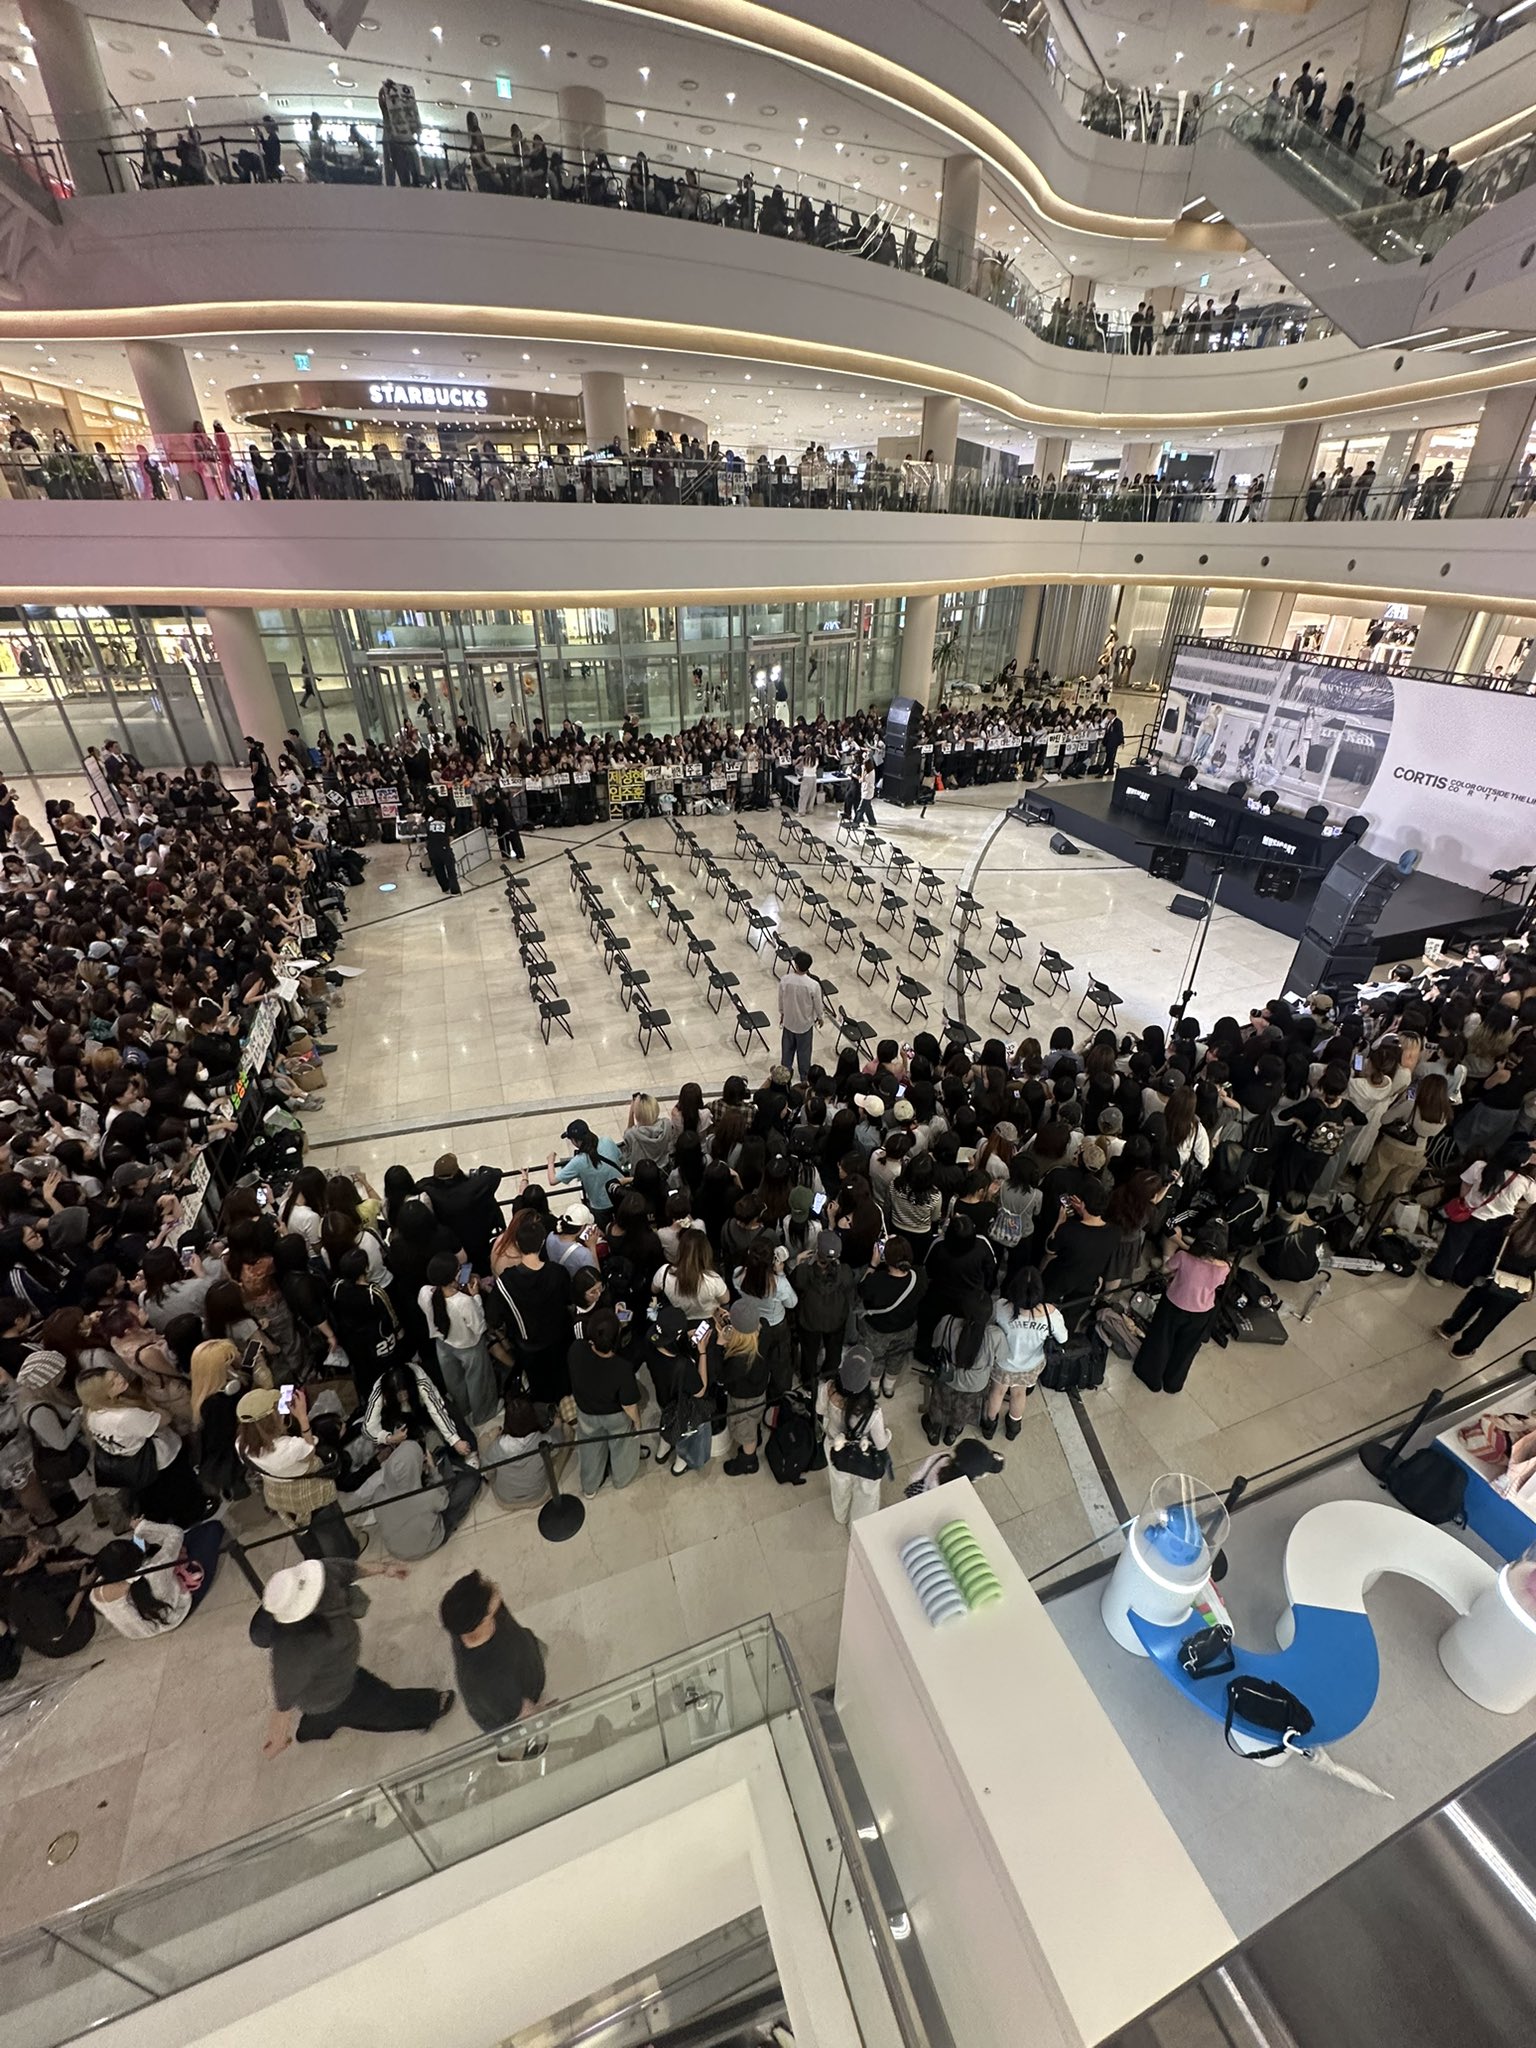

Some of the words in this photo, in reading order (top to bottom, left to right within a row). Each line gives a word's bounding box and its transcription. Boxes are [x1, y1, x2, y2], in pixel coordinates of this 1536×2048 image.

[369, 384, 489, 408] STARBUCKS
[1394, 767, 1448, 789] CORTIS
[1448, 785, 1460, 793] CO
[1450, 779, 1477, 791] COLOR
[1476, 784, 1510, 799] OUTSIDE
[1510, 792, 1527, 803] THE
